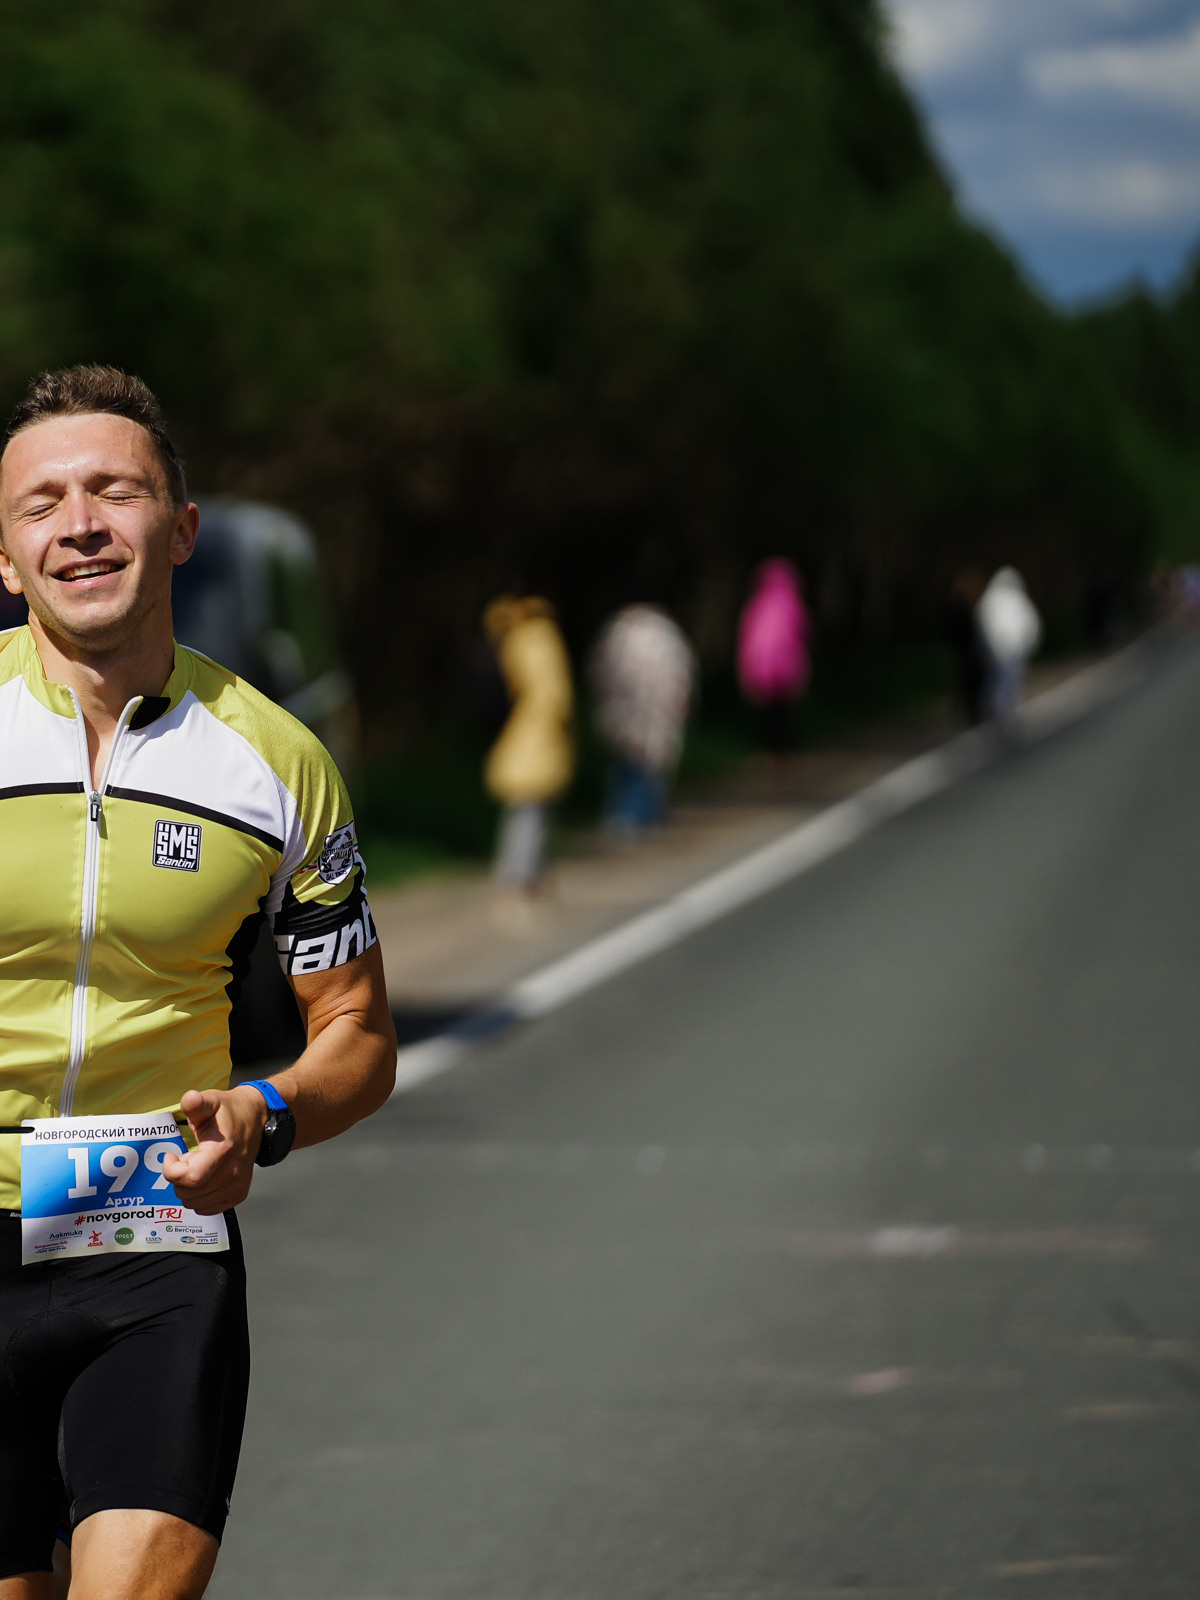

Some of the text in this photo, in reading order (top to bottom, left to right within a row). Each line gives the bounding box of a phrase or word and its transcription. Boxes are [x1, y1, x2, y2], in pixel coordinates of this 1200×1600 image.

[156, 823, 199, 860] SMS
[156, 855, 196, 869] Santini
[35, 1126, 125, 1141] НОВГОРОДСКИЙ
[68, 1141, 184, 1199] 199
[105, 1196, 145, 1208] Артур
